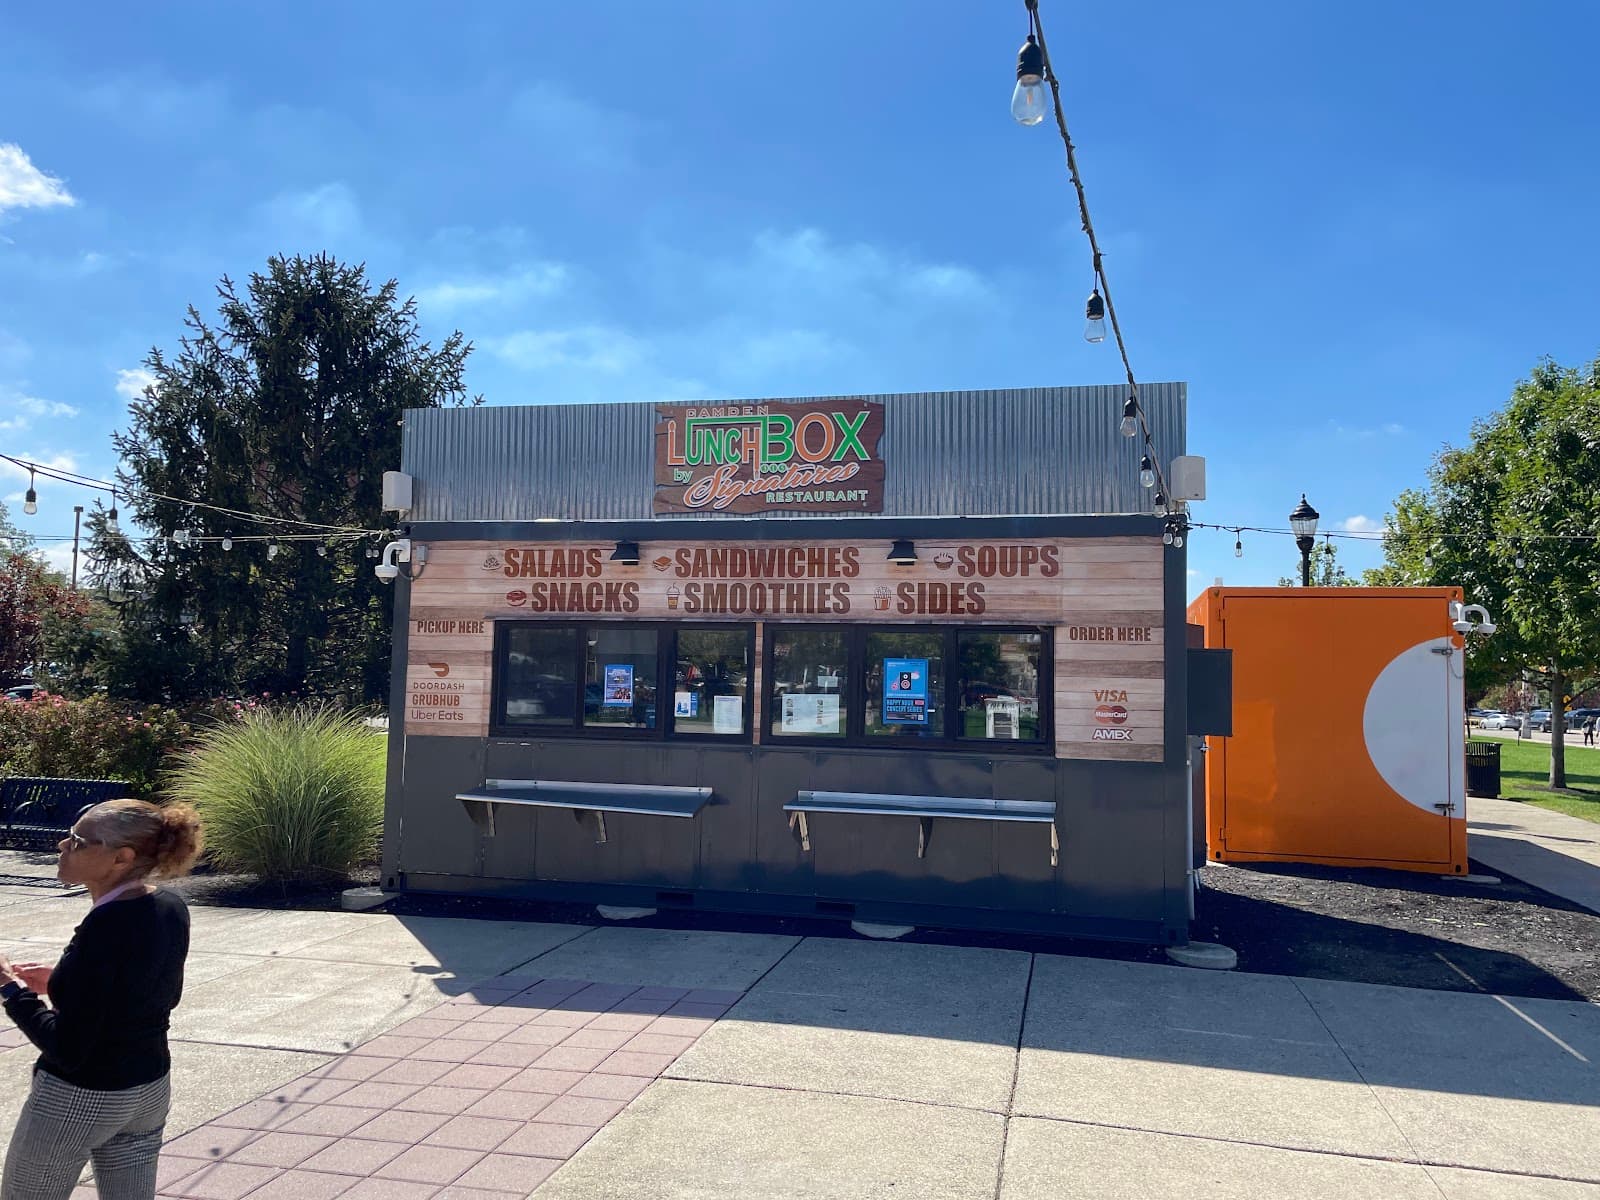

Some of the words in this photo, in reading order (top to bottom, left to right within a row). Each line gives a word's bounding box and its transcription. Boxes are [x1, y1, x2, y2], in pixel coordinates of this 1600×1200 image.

[673, 468, 693, 484] by
[683, 461, 860, 510] Signatures
[766, 489, 868, 503] RESTAURANT
[504, 548, 602, 578] SALADS
[674, 547, 860, 578] SANDWICHES
[957, 545, 1059, 577] SOUPS
[531, 582, 640, 612] SNACKS
[684, 582, 851, 614] SMOOTHIES
[896, 582, 986, 614] SIDES
[417, 620, 456, 633] PICKUP
[458, 620, 485, 634] HERE
[1069, 626, 1114, 641] ORDER
[1117, 627, 1152, 642] HERE
[413, 682, 465, 690] DOORDASH
[412, 694, 460, 706] GRUBHUB
[1093, 689, 1129, 702] VISA
[411, 710, 436, 720] Uber
[438, 710, 464, 721] Eats
[1093, 728, 1133, 741] AMEX
